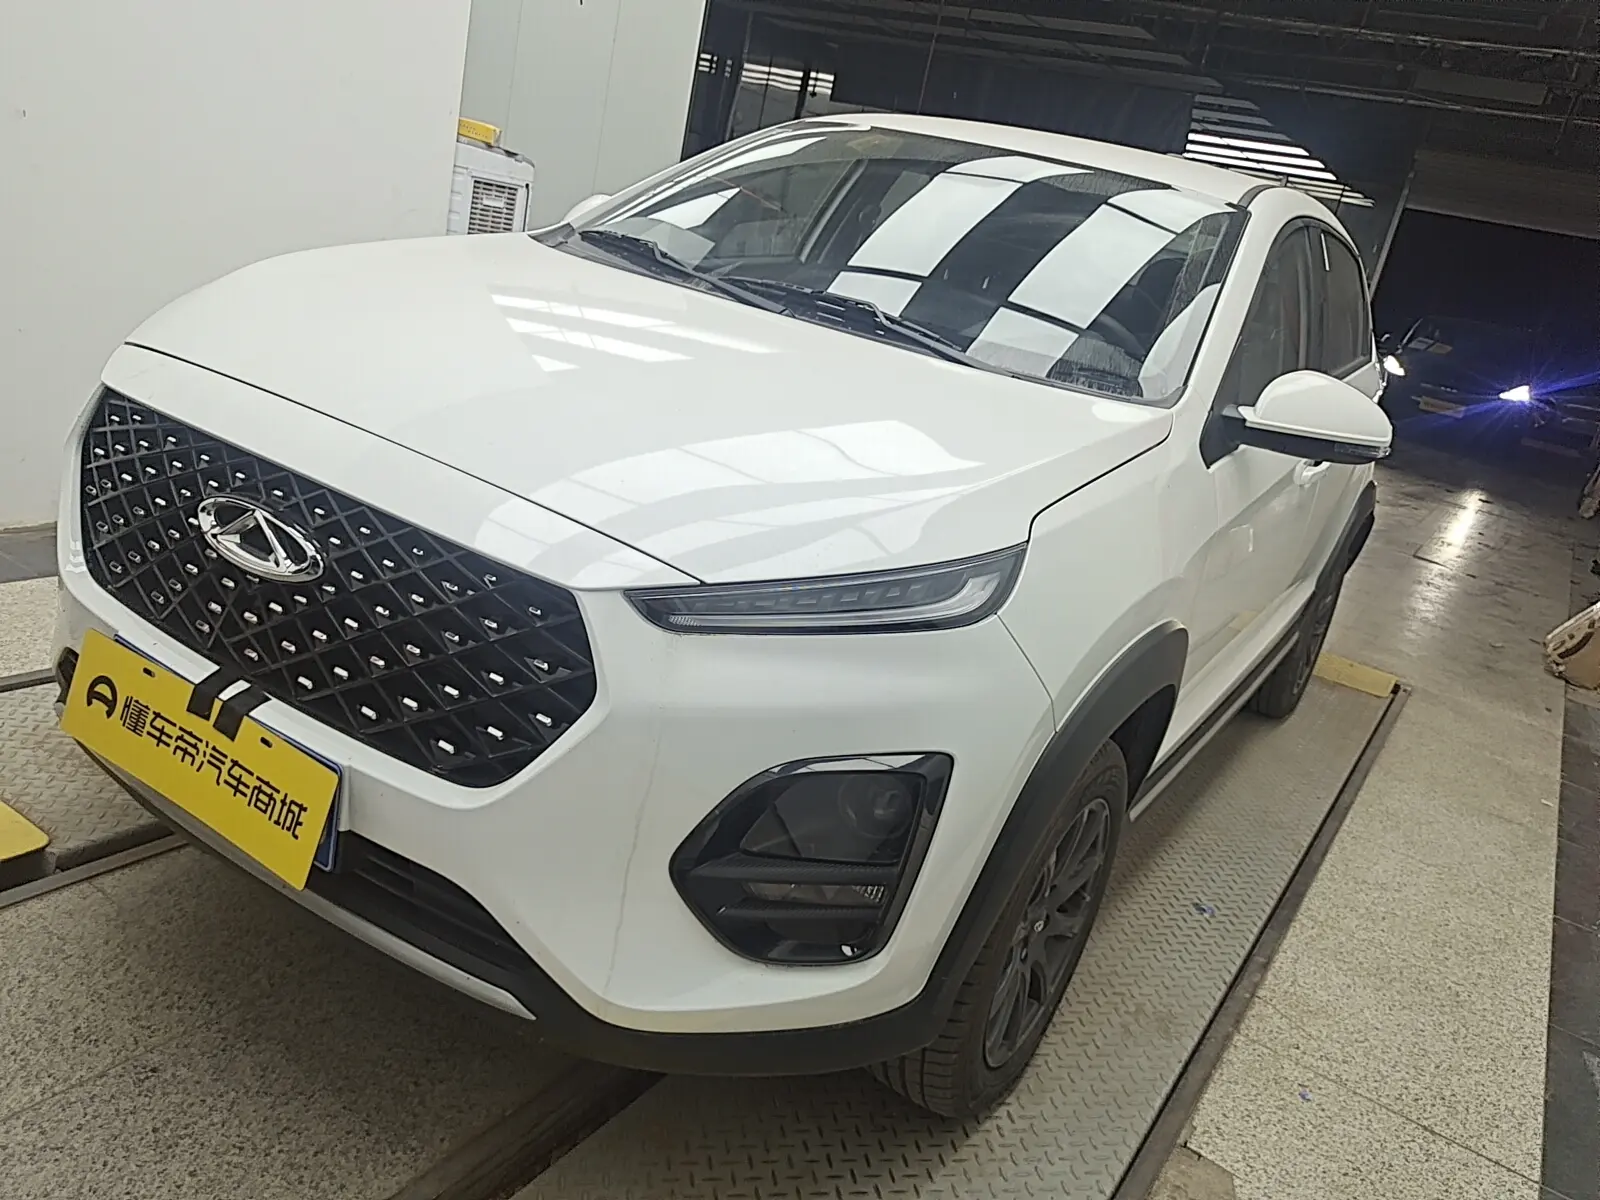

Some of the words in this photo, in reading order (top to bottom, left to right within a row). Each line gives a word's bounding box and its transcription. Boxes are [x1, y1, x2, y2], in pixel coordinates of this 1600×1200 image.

[120, 696, 308, 839] 懂车帝汽车商城
